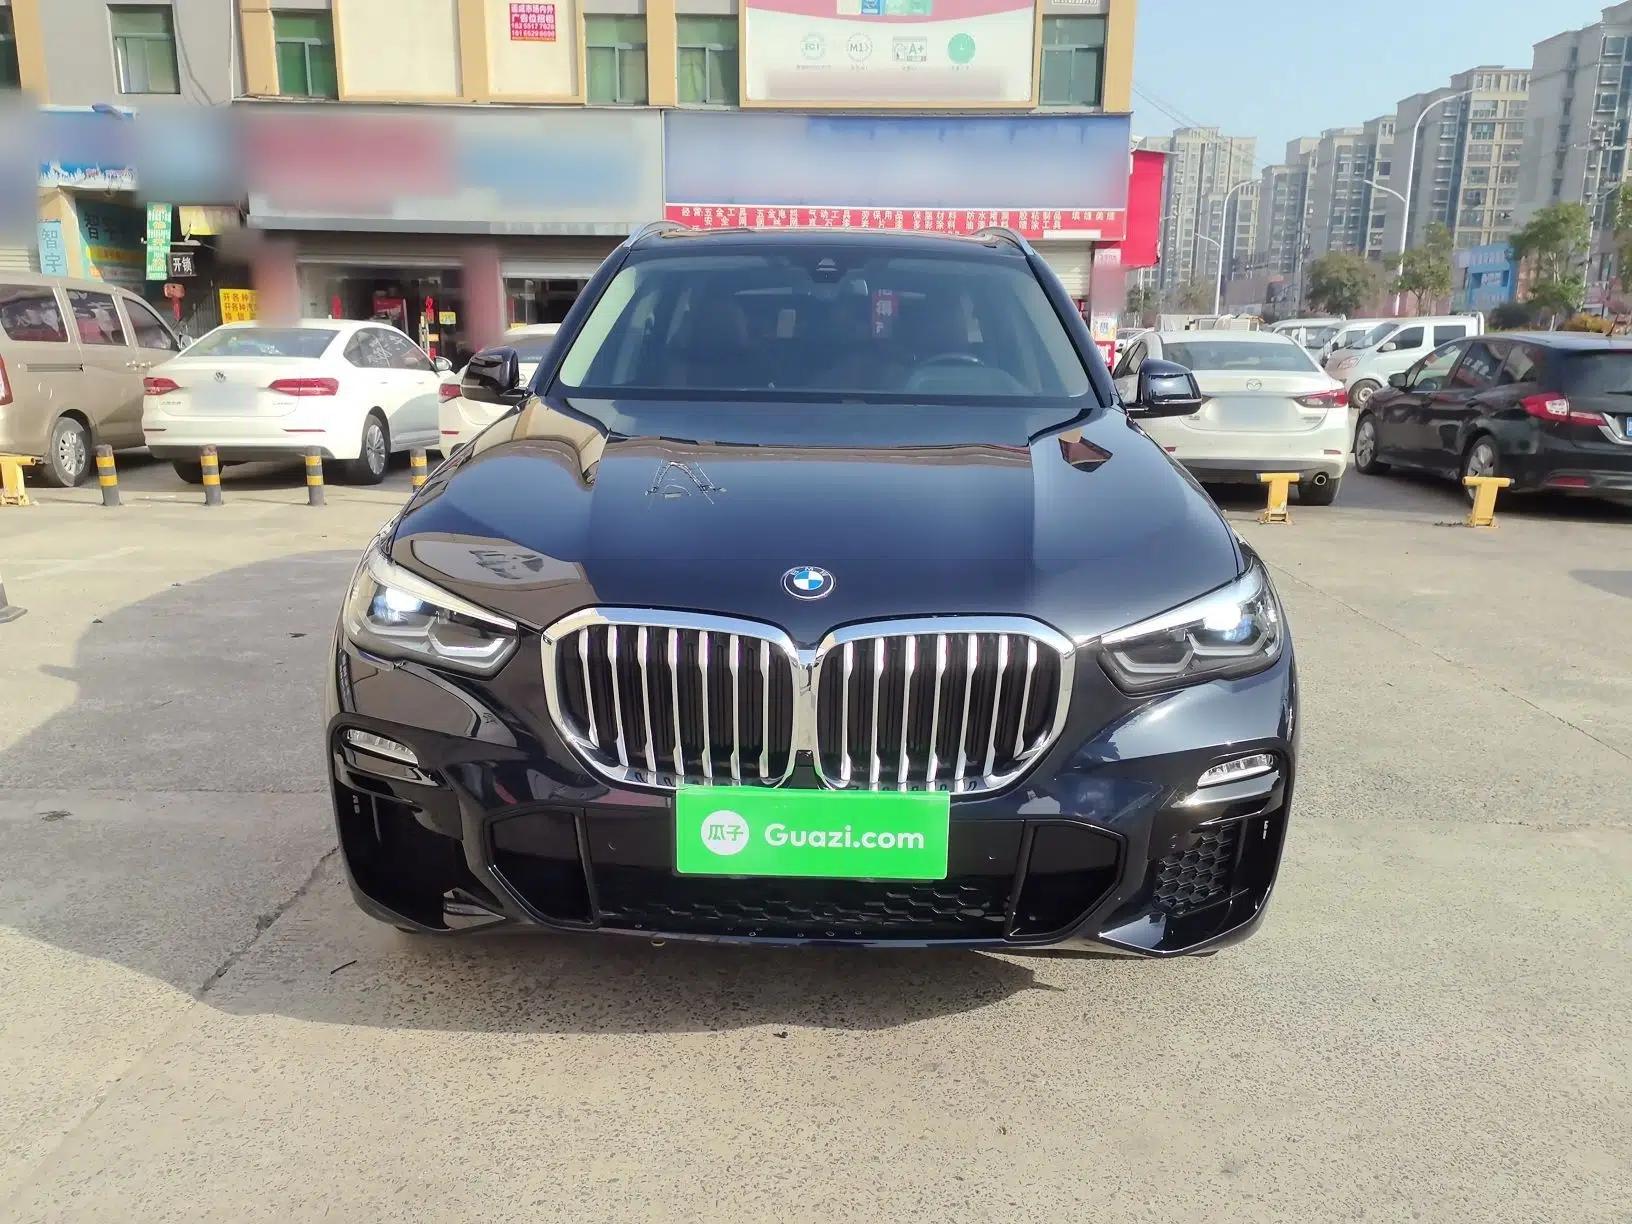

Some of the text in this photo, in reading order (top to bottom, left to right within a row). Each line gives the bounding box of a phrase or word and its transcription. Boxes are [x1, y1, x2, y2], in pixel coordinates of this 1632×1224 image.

[173, 256, 192, 273] 开锁
[707, 824, 744, 842] 瓜子
[764, 823, 924, 849] Guazi.com
